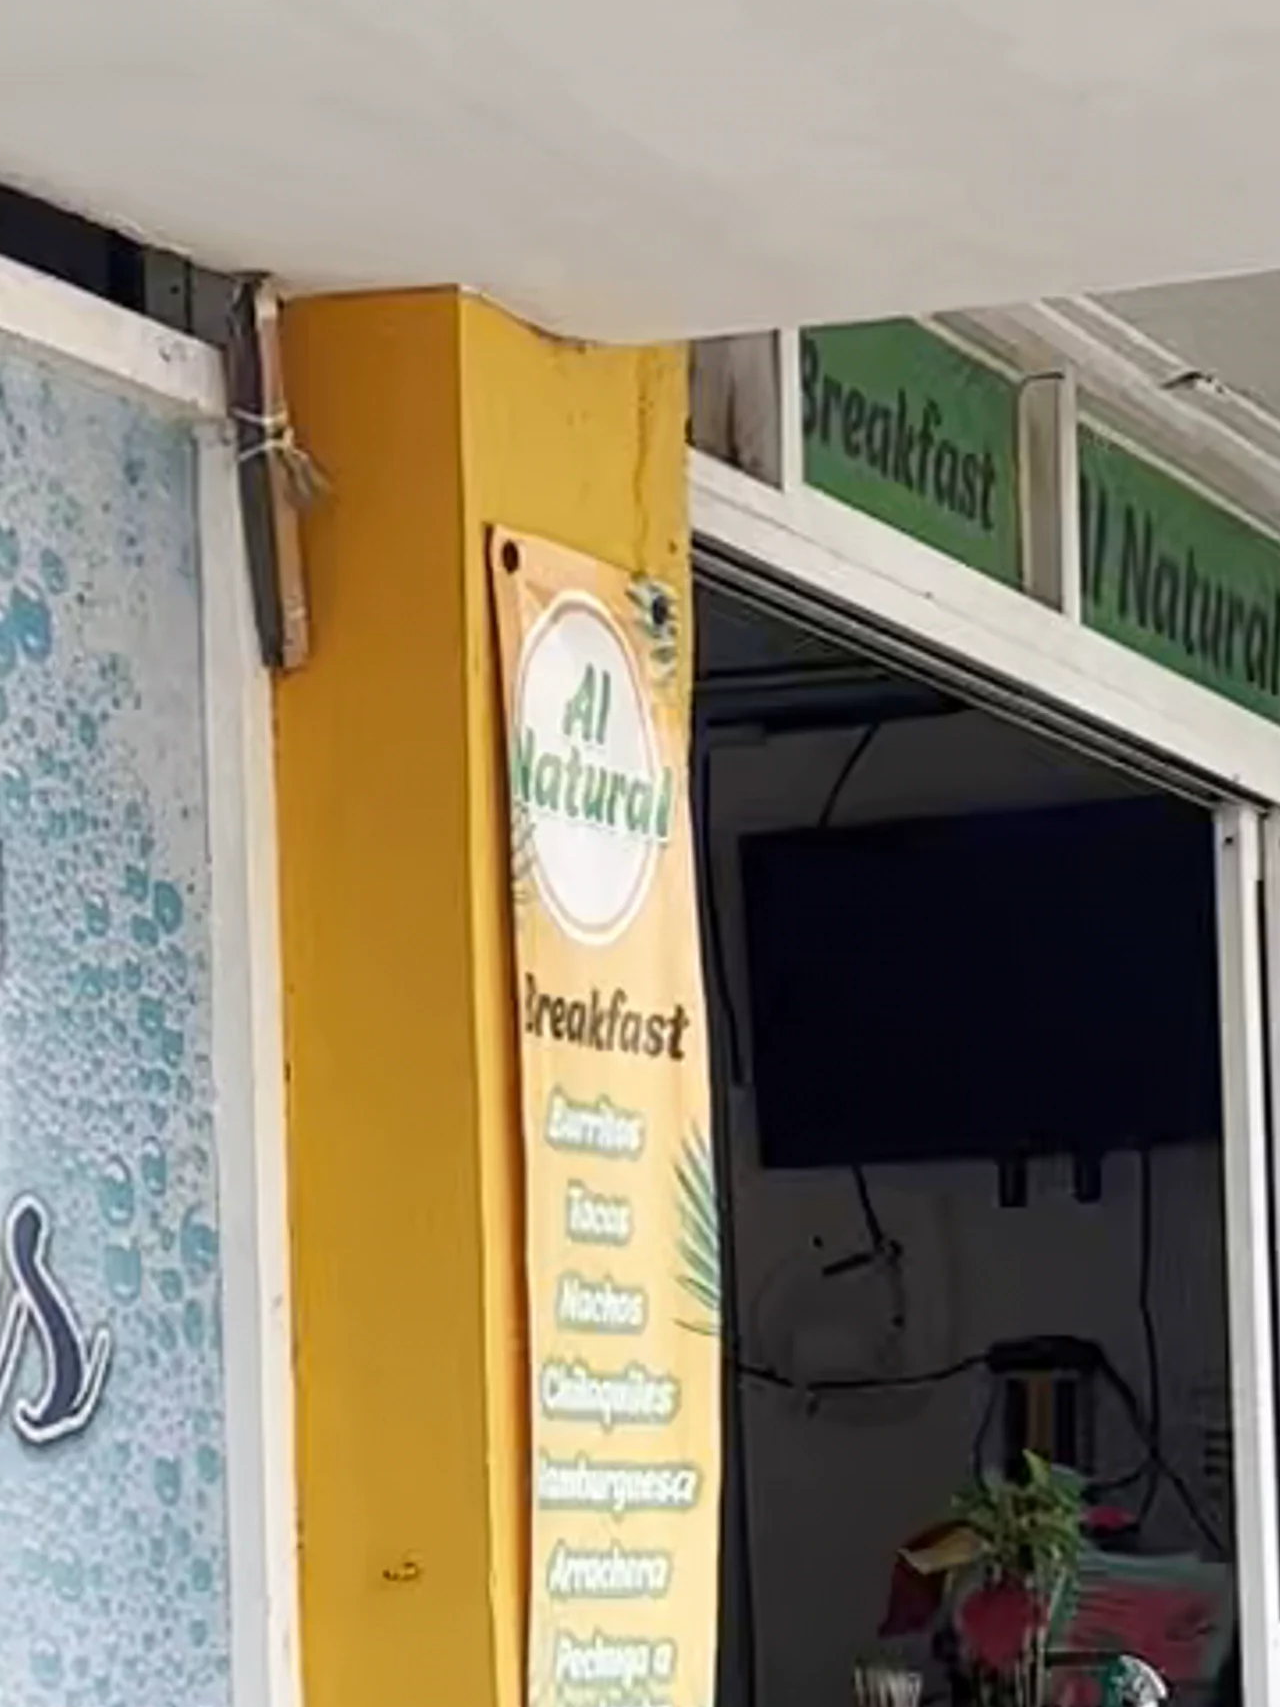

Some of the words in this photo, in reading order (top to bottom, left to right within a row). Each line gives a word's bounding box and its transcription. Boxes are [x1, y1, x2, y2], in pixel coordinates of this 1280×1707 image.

[561, 661, 612, 746] Al
[511, 725, 674, 838] Natural
[566, 1182, 632, 1239] Tacos
[557, 1274, 645, 1331] Nachos
